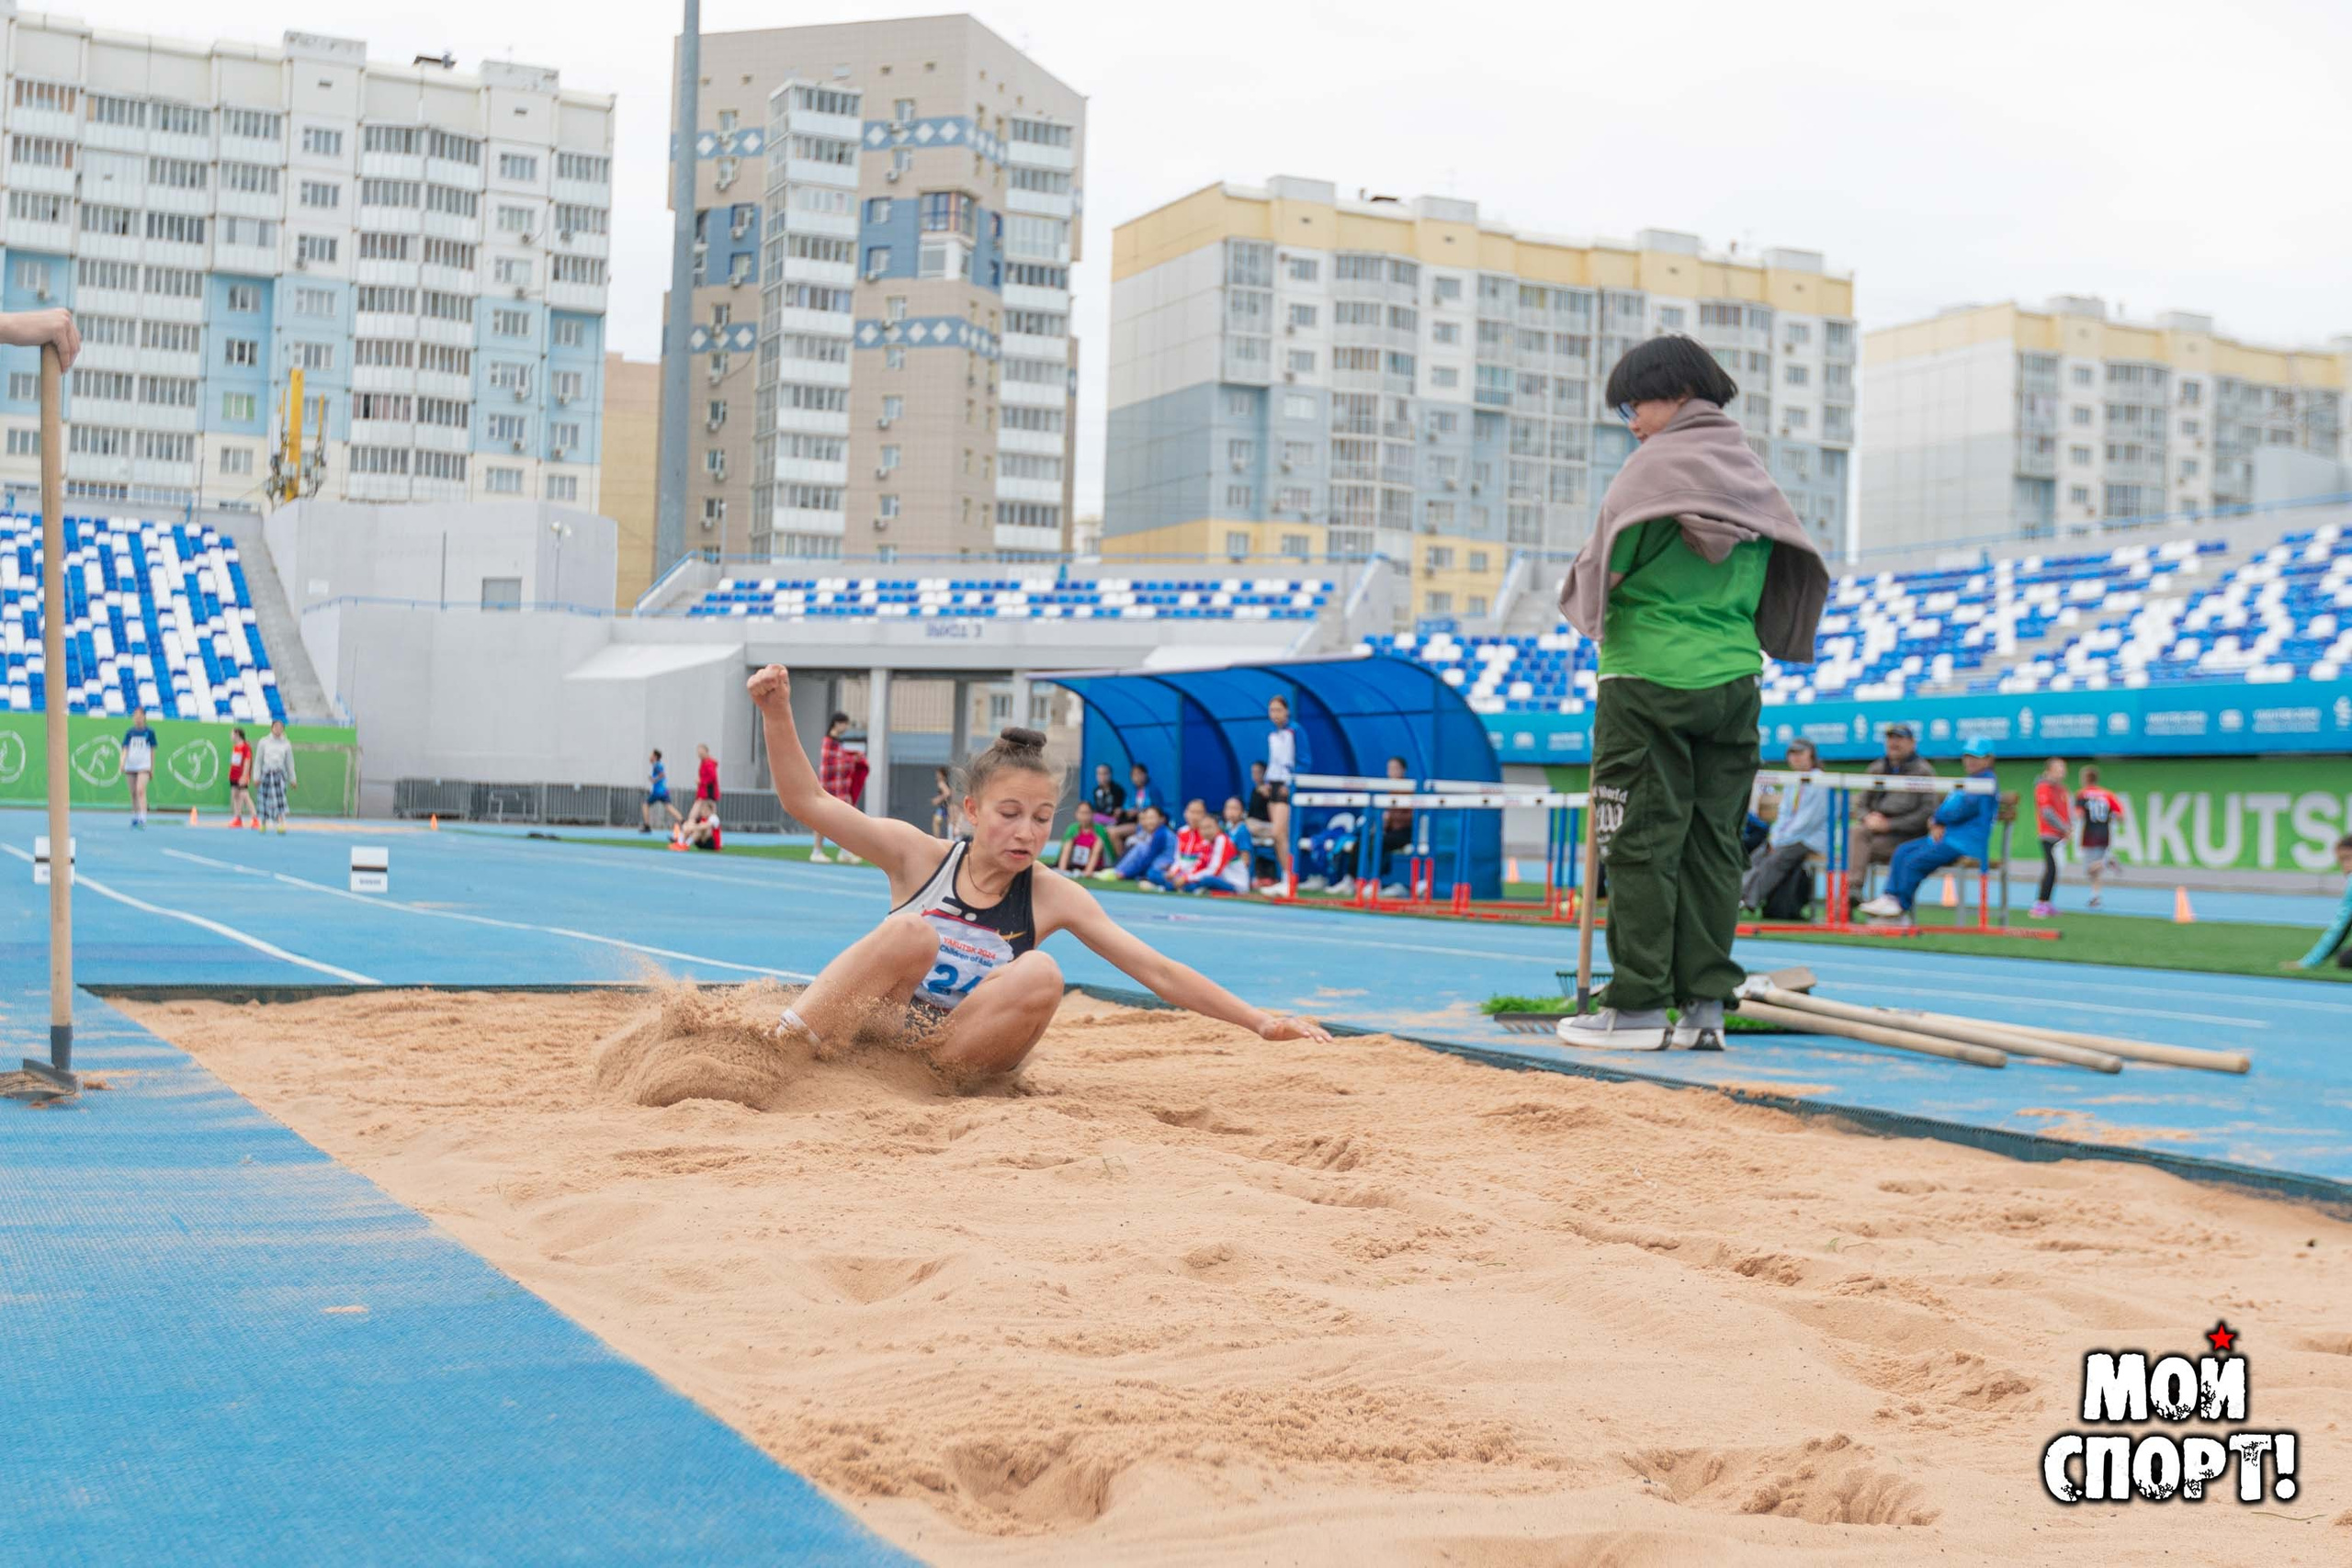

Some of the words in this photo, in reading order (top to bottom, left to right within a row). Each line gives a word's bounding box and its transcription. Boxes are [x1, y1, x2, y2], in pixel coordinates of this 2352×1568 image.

[2071, 791, 2352, 868] AKUTS
[939, 943, 969, 961] Children
[978, 957, 993, 968] Asia
